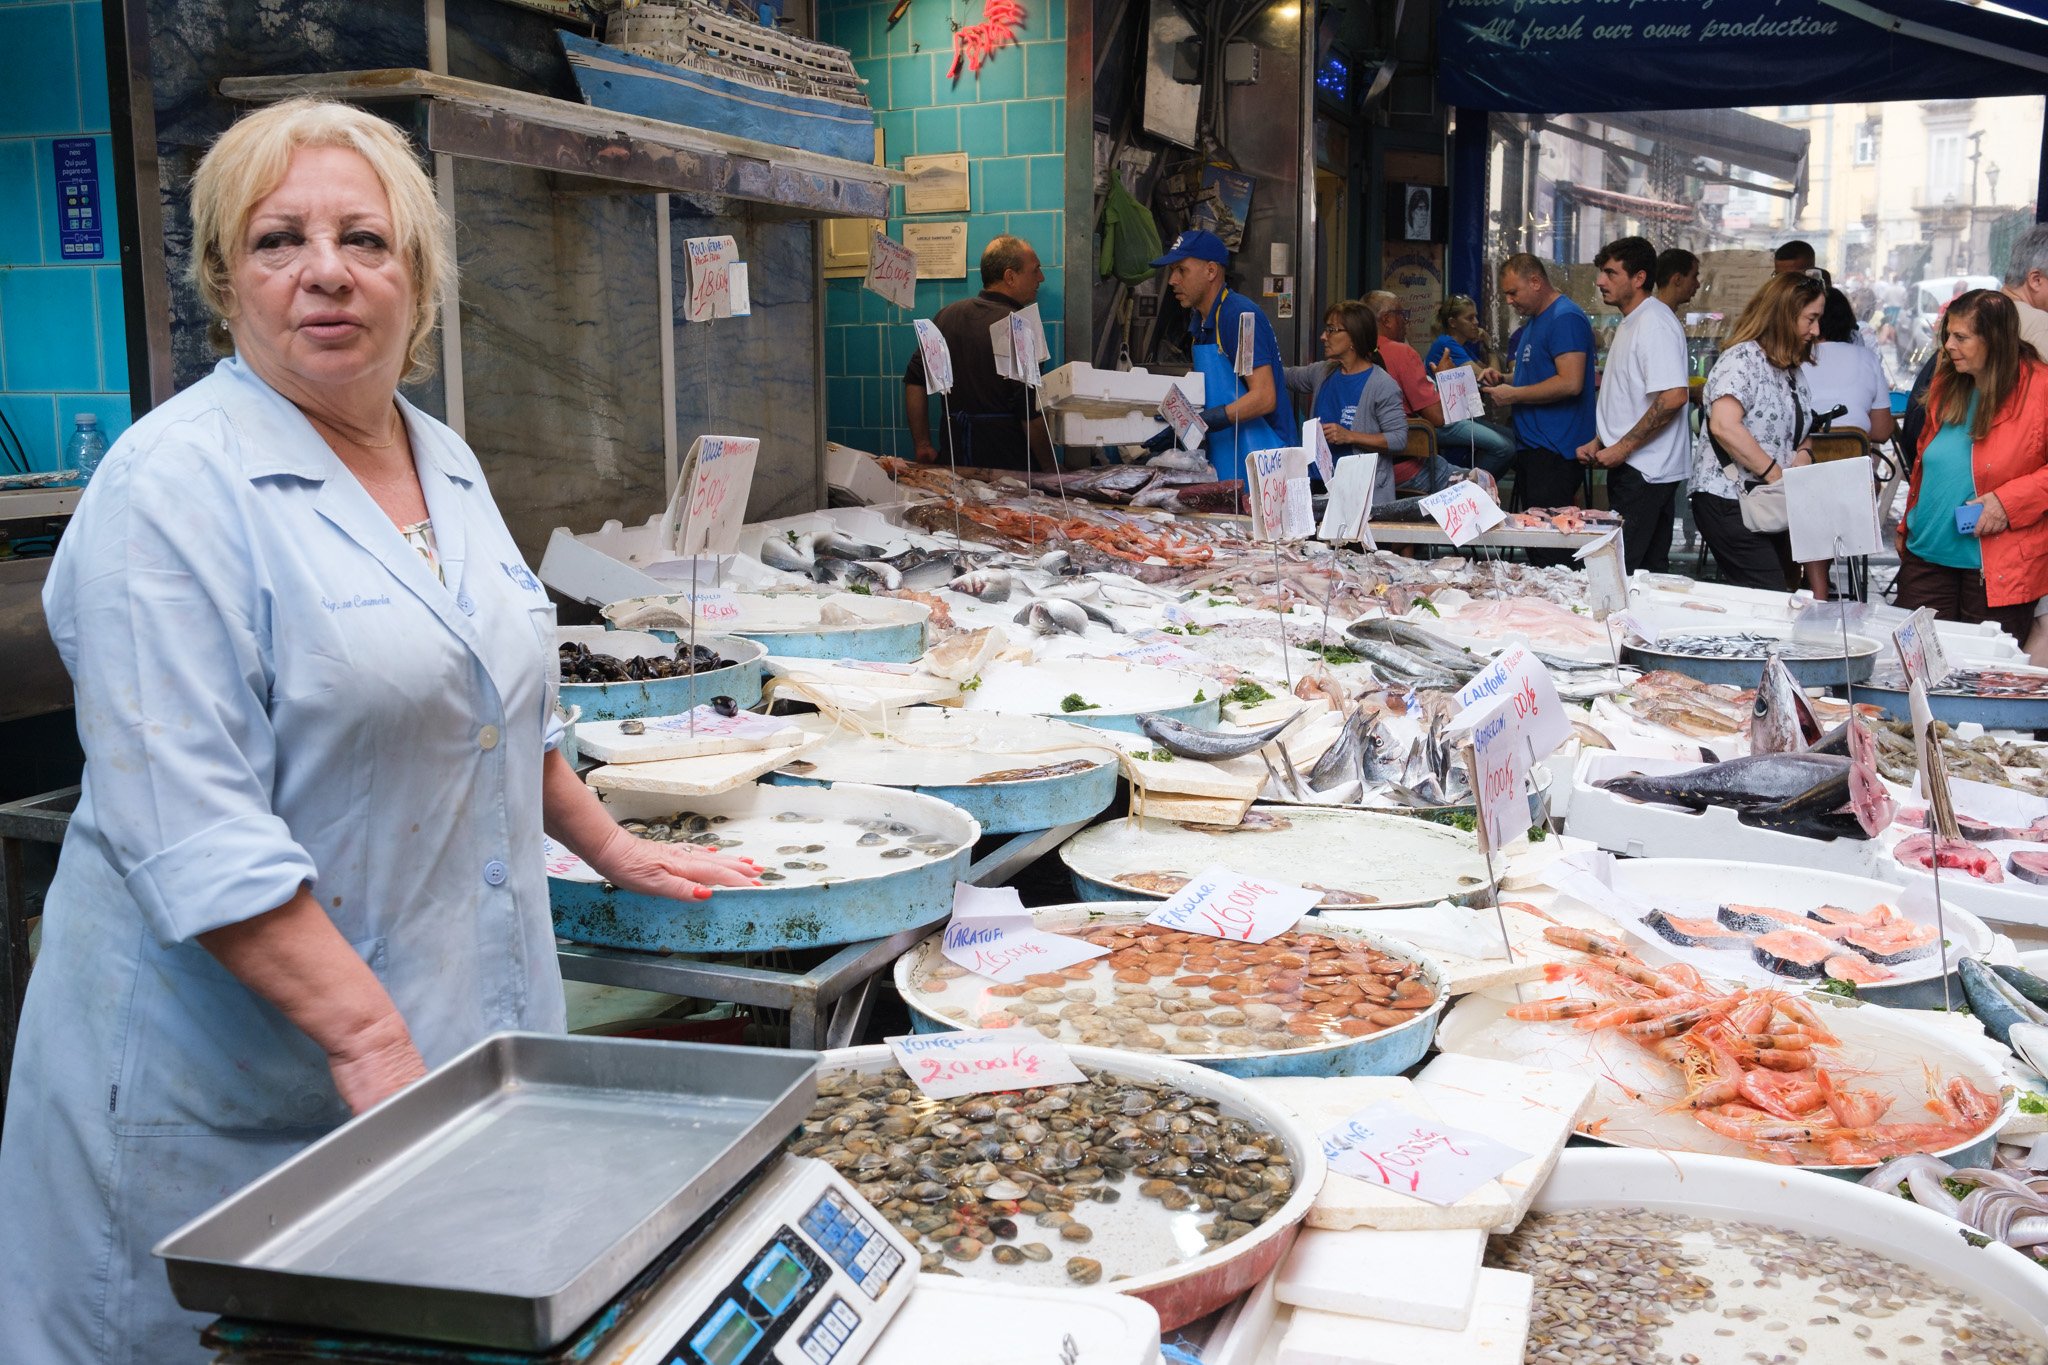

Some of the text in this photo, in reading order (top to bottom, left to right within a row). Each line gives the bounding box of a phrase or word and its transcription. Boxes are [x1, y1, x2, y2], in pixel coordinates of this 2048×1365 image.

[1467, 14, 1838, 49] All fresh our own production
[62, 168, 80, 176] pagare
[65, 159, 87, 168] Qui puoi
[1258, 450, 1282, 476] ORATE
